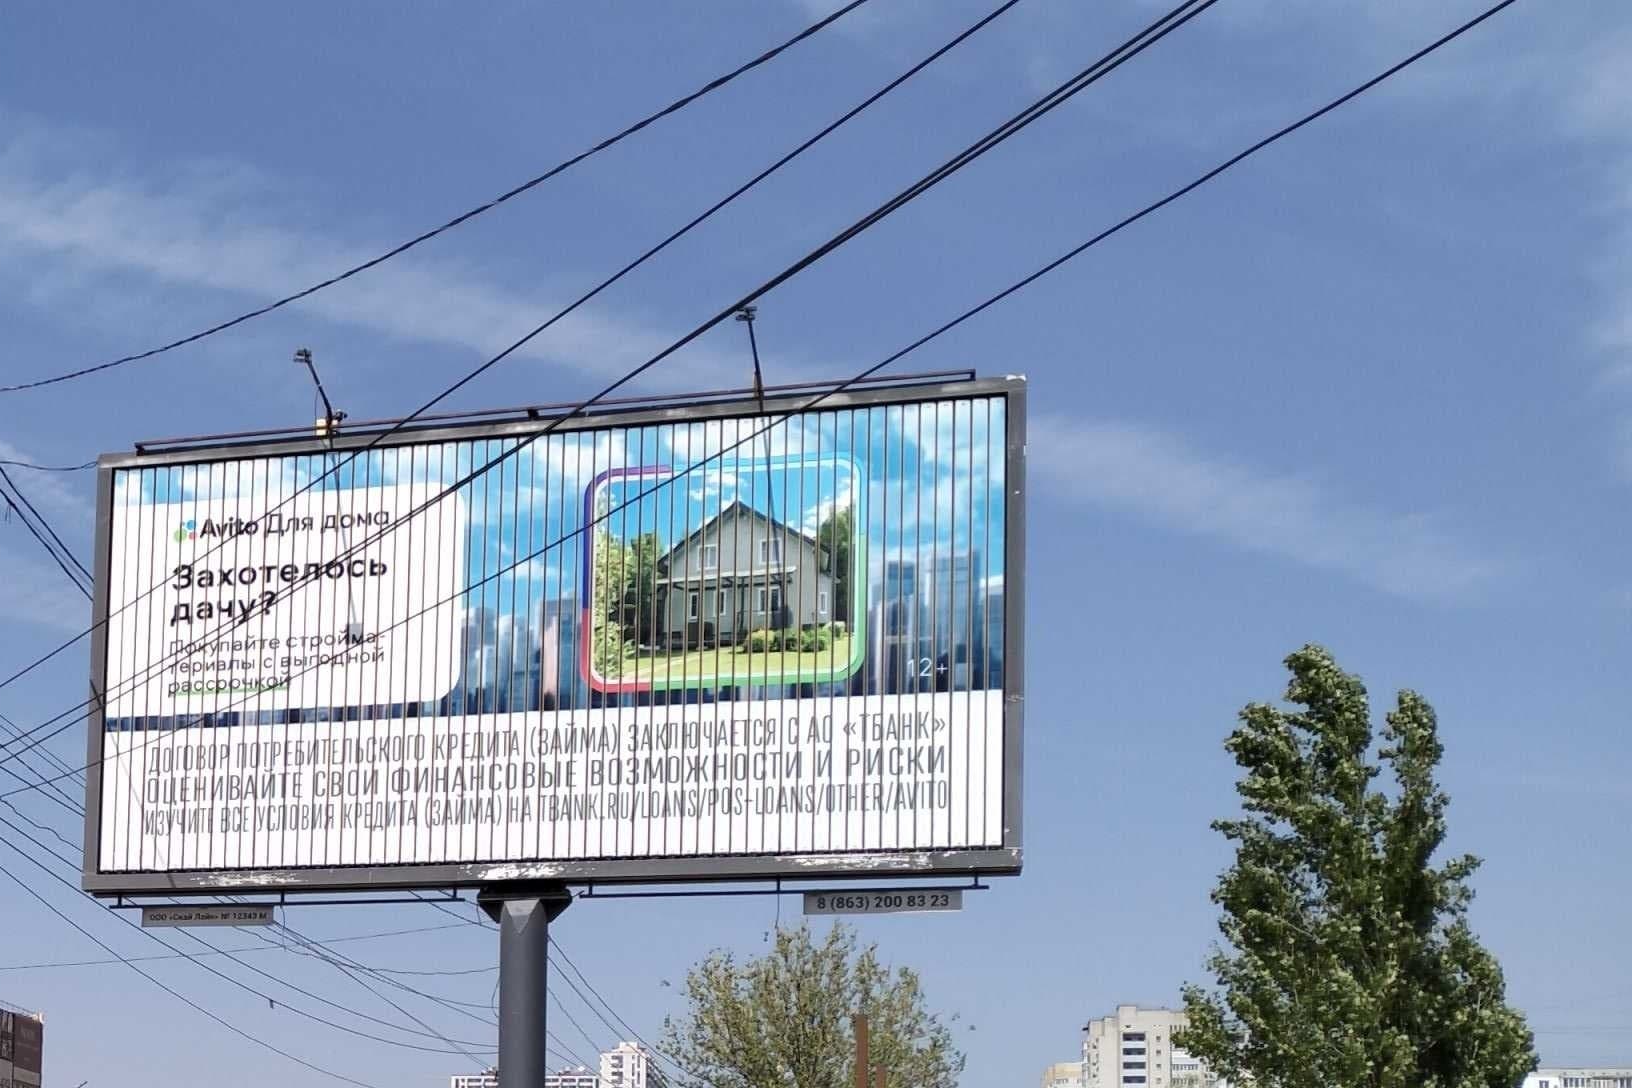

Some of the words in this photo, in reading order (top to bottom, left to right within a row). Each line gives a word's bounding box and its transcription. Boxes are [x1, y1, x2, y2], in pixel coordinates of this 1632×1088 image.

[200, 516, 259, 539] Avito
[267, 514, 313, 538] Для
[321, 511, 390, 530] дома
[172, 557, 388, 590] Захотелось
[169, 590, 276, 626] дачу?
[169, 635, 281, 660] Покупайте
[169, 657, 256, 676] териалы
[263, 656, 274, 669] с
[908, 657, 948, 678] 12+
[168, 669, 292, 698] рассрочкой
[148, 743, 230, 776] ДОГОВОР
[236, 734, 425, 769] ПОТРЕБИТЕЛЬСКОГО
[435, 729, 520, 762] КРЕДИТА
[530, 722, 619, 759] (ЗАЙМА)
[627, 717, 777, 751] ЗАКЛЮЧАЕТСЯ
[787, 716, 800, 746] С
[842, 710, 946, 743] «ТБАНК»
[146, 769, 304, 806] ОЦЕНИВАЙТЕ
[314, 769, 379, 798] СВОИ
[391, 759, 578, 795] ФИНАНСОВЫЕ
[590, 751, 803, 787] ВОЗМОЖНОСТИ
[817, 749, 833, 779] И
[847, 745, 946, 777] РИСКИ
[144, 807, 214, 836] ИЗУЧИТЕ
[220, 804, 250, 833] ВСЕ
[257, 802, 335, 832] УСЛОВИЯ
[343, 799, 417, 832] КРЕДИТА
[424, 794, 503, 829] (ЗАЙМА)
[510, 796, 532, 823] НА
[817, 897, 826, 909] 8
[830, 896, 870, 910] (863)
[874, 895, 902, 908] 200
[907, 895, 926, 907] 83
[930, 894, 949, 907] 23
